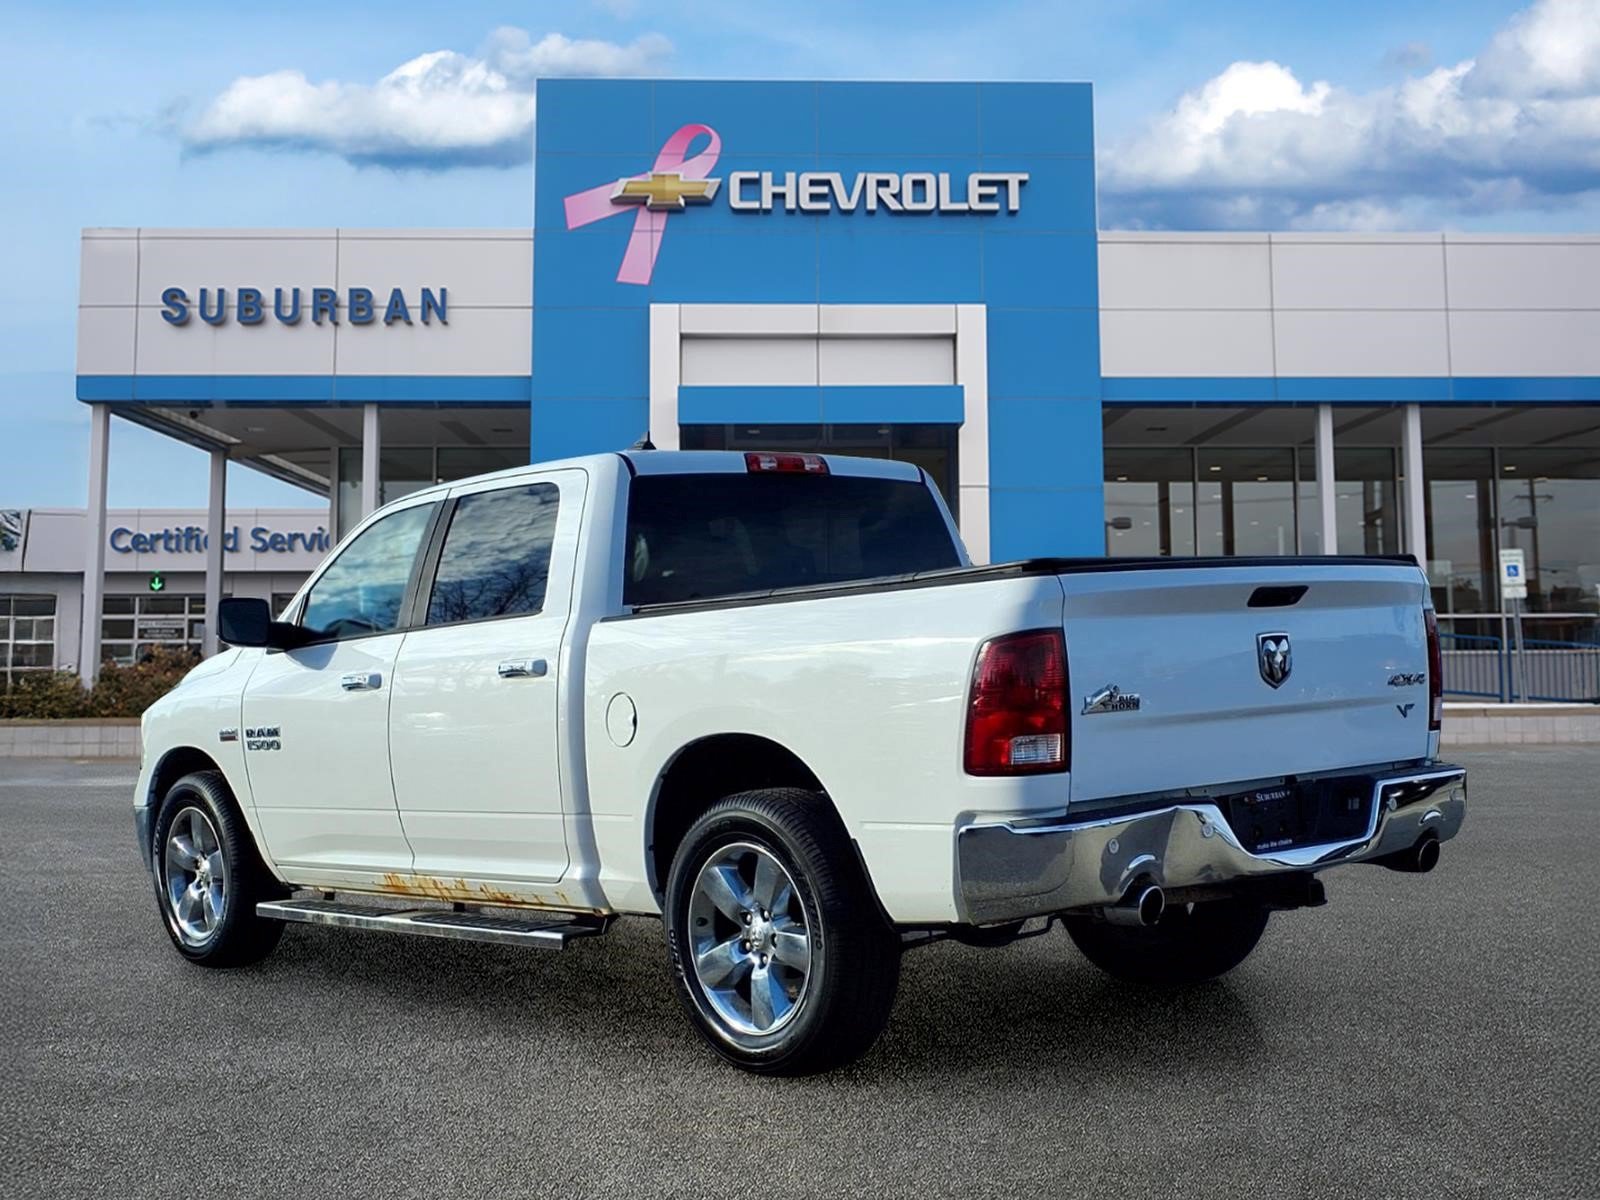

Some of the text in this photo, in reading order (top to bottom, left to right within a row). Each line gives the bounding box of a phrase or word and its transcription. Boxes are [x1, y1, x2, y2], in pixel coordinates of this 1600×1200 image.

[729, 170, 1030, 214] CHEVROLET
[161, 286, 449, 326] SUBURBAN
[109, 526, 240, 553] Certifid
[245, 727, 281, 739] RAM
[246, 739, 282, 751] 1500
